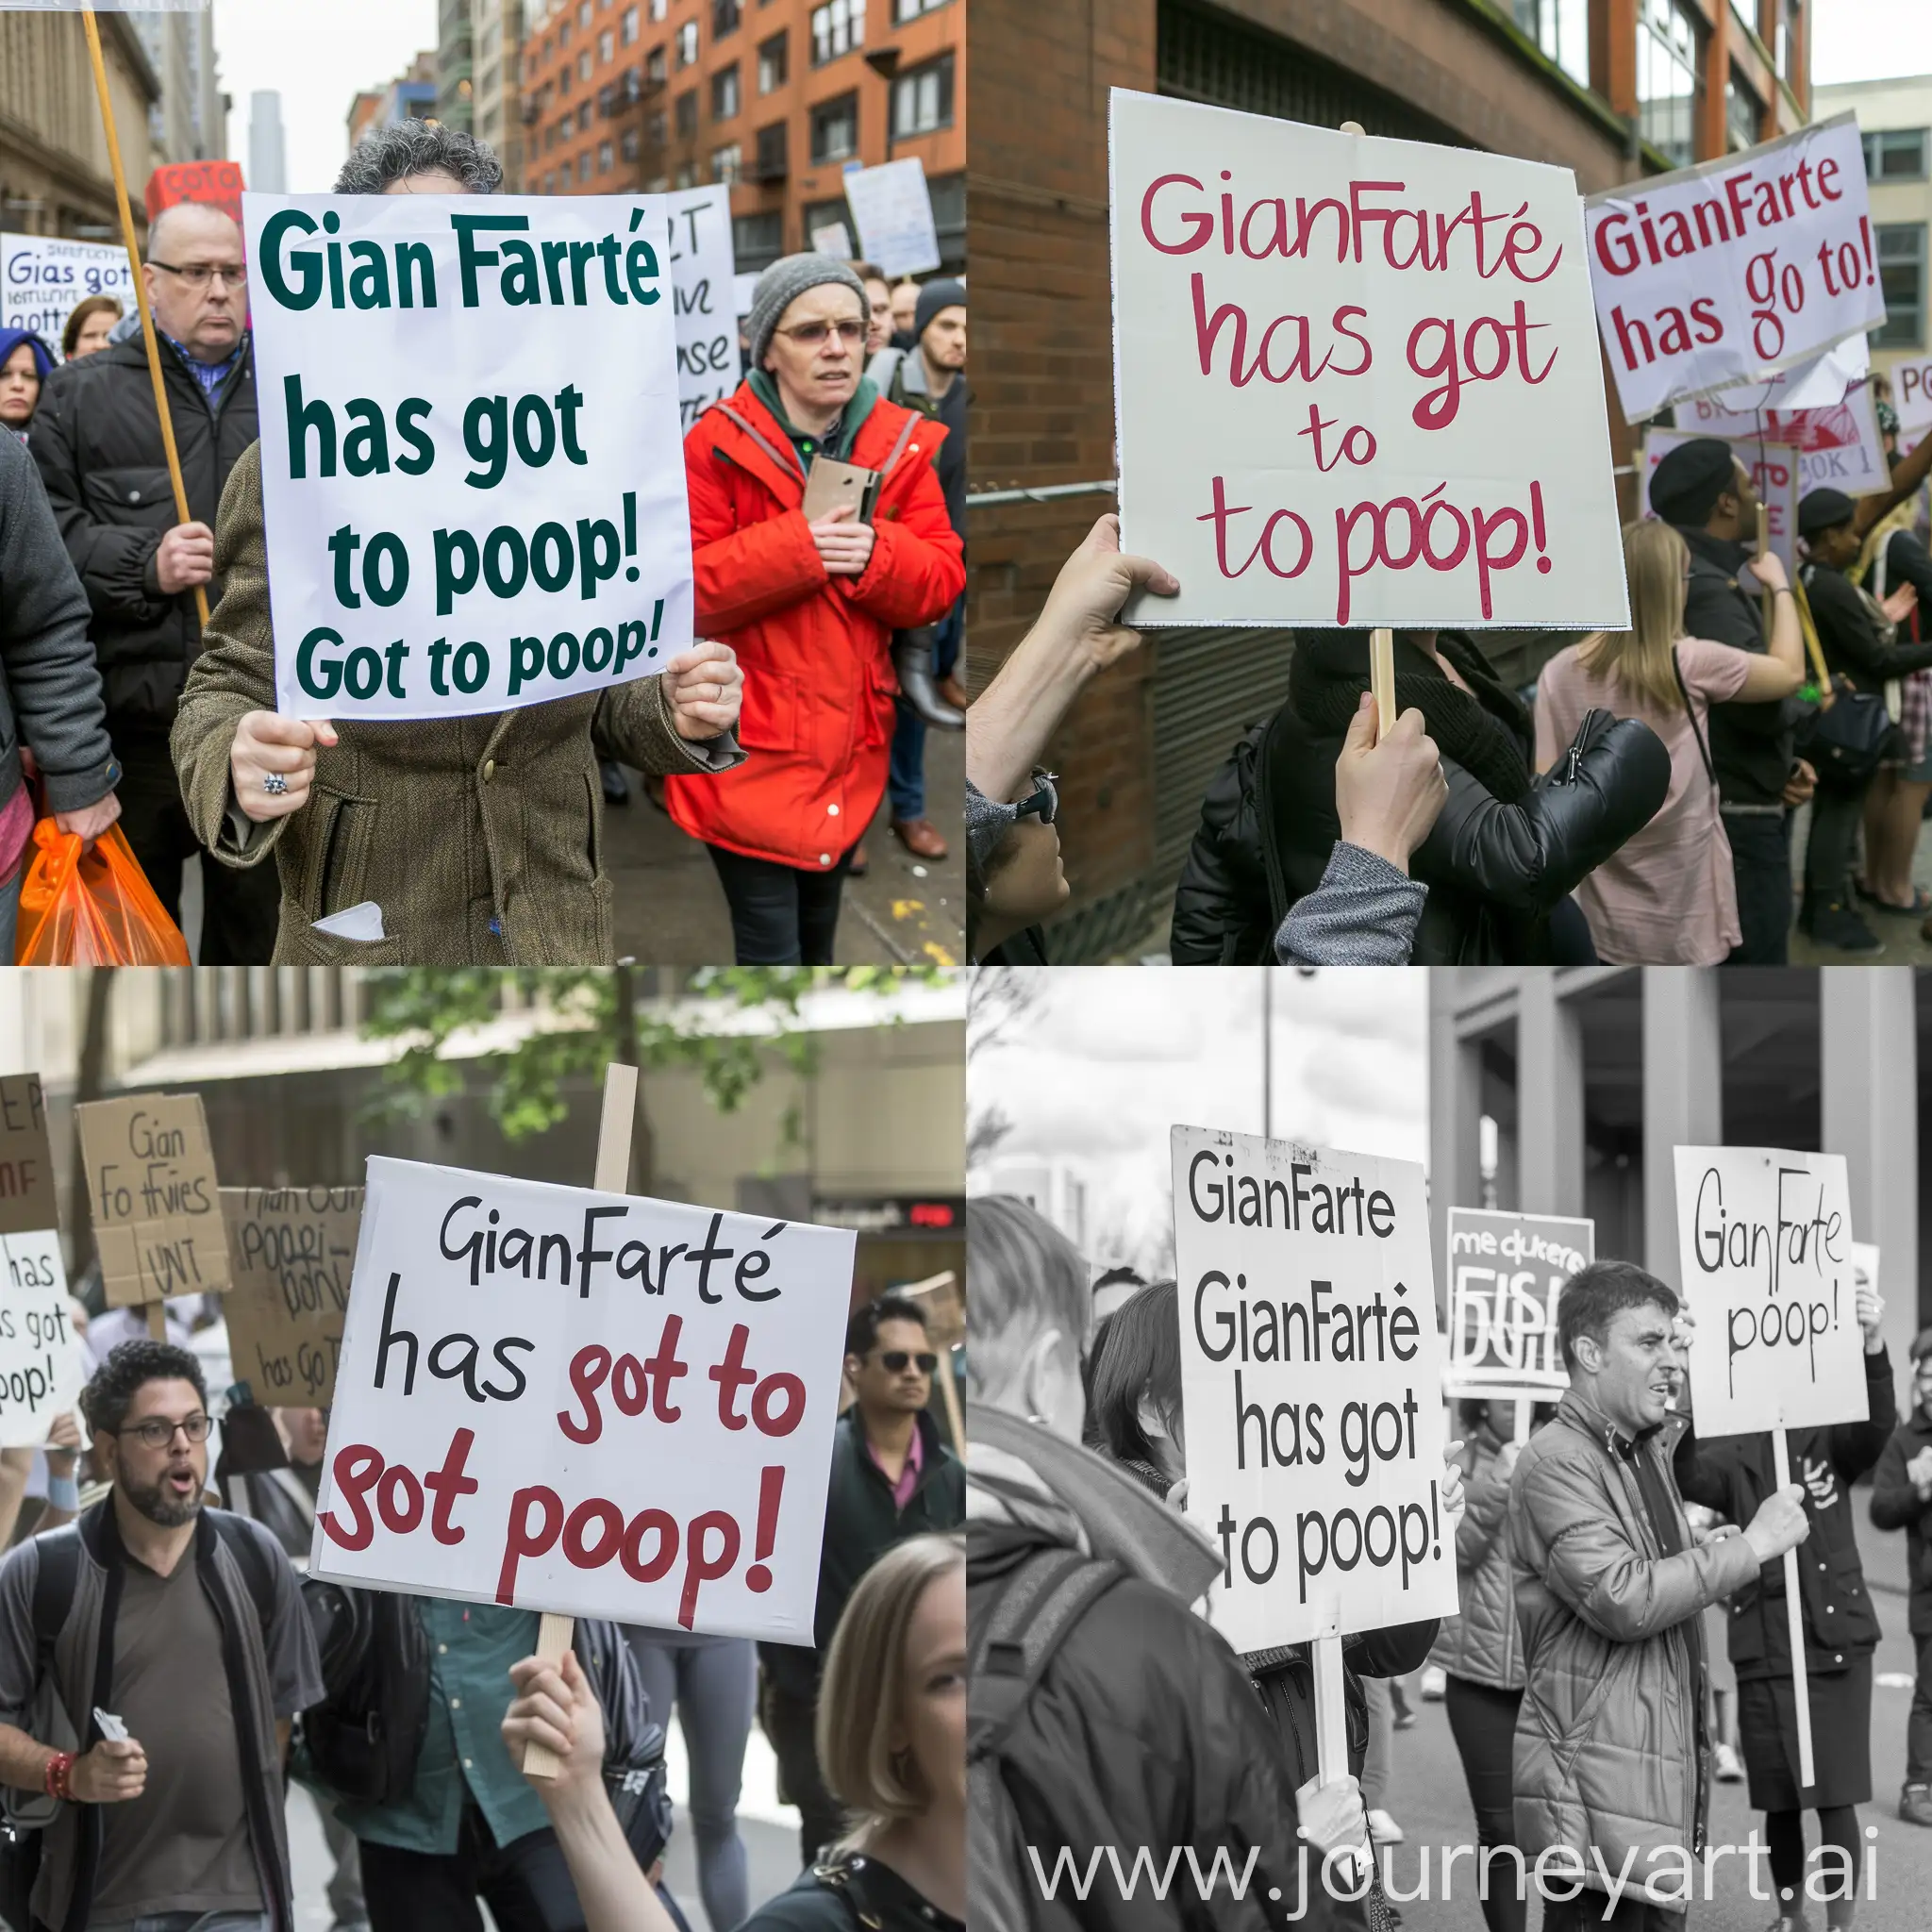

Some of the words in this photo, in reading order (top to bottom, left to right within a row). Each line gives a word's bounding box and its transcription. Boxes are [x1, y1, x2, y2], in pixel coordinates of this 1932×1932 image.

[8, 251, 75, 285] Gias
[84, 265, 130, 294] got
[259, 209, 437, 311] Gian
[450, 208, 661, 308] Farrté
[1141, 170, 1562, 282] GianFarté
[1594, 158, 1842, 276] GianFarte
[1610, 297, 1724, 371] has
[1746, 247, 1805, 360] go
[1817, 215, 1875, 297] to!
[1191, 273, 1373, 388] has
[1407, 300, 1558, 430] got
[284, 374, 436, 479] has
[462, 383, 588, 490] got
[1297, 404, 1377, 472] to
[328, 524, 410, 609] to
[433, 491, 641, 616] poop!
[1196, 476, 1313, 579] to
[296, 627, 409, 700] Got
[427, 637, 490, 696] to
[508, 599, 665, 696] poop!
[440, 1196, 787, 1304] GianFarté
[1189, 1150, 1395, 1238] GianFarte
[27, 1304, 67, 1349] got
[374, 1273, 535, 1403] has
[557, 1314, 688, 1444] got
[709, 1324, 806, 1437] to
[1728, 1279, 1840, 1399] poop!
[1234, 1370, 1325, 1470] has
[1341, 1389, 1418, 1487] got
[316, 1427, 478, 1552] got
[495, 1466, 785, 1631] poop!
[1217, 1504, 1278, 1589] to
[1296, 1480, 1441, 1604] poop!
